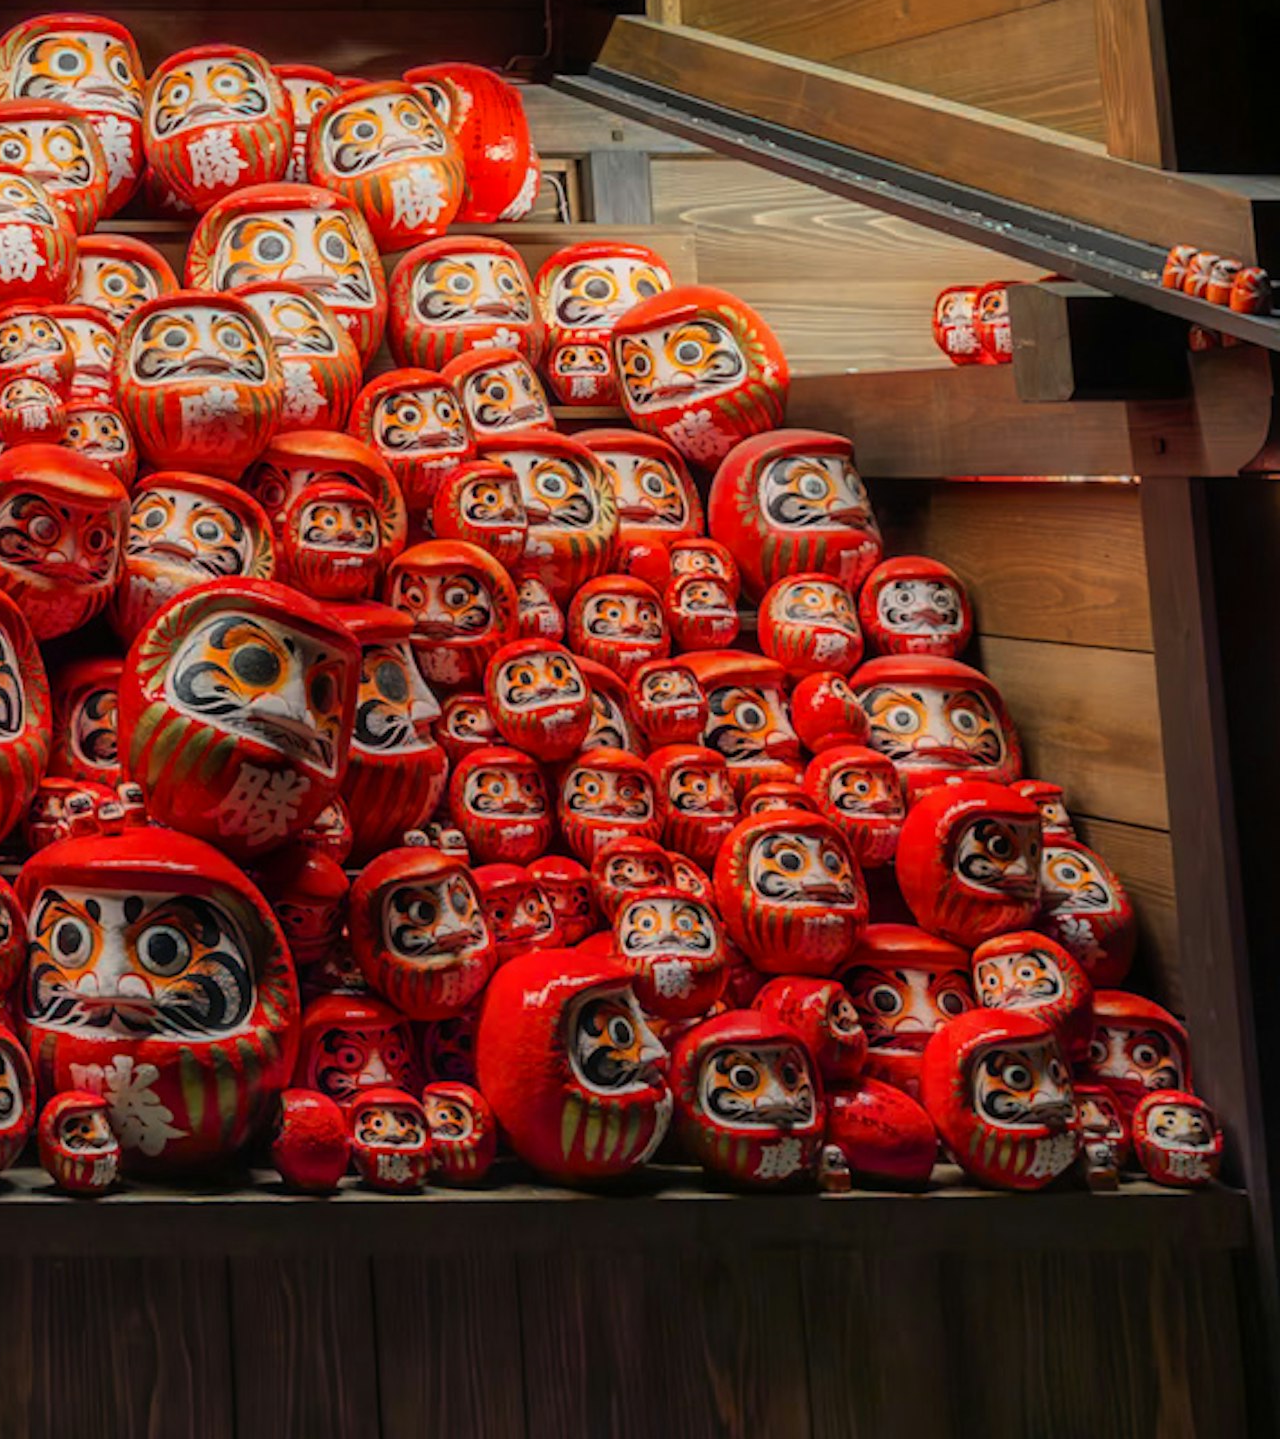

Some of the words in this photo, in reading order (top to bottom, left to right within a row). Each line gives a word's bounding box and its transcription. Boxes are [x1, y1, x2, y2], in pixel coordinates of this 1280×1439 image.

[188, 130, 248, 189] 勝
[393, 165, 447, 229] 勝
[212, 763, 310, 845] 勝
[755, 1139, 802, 1179] 勝
